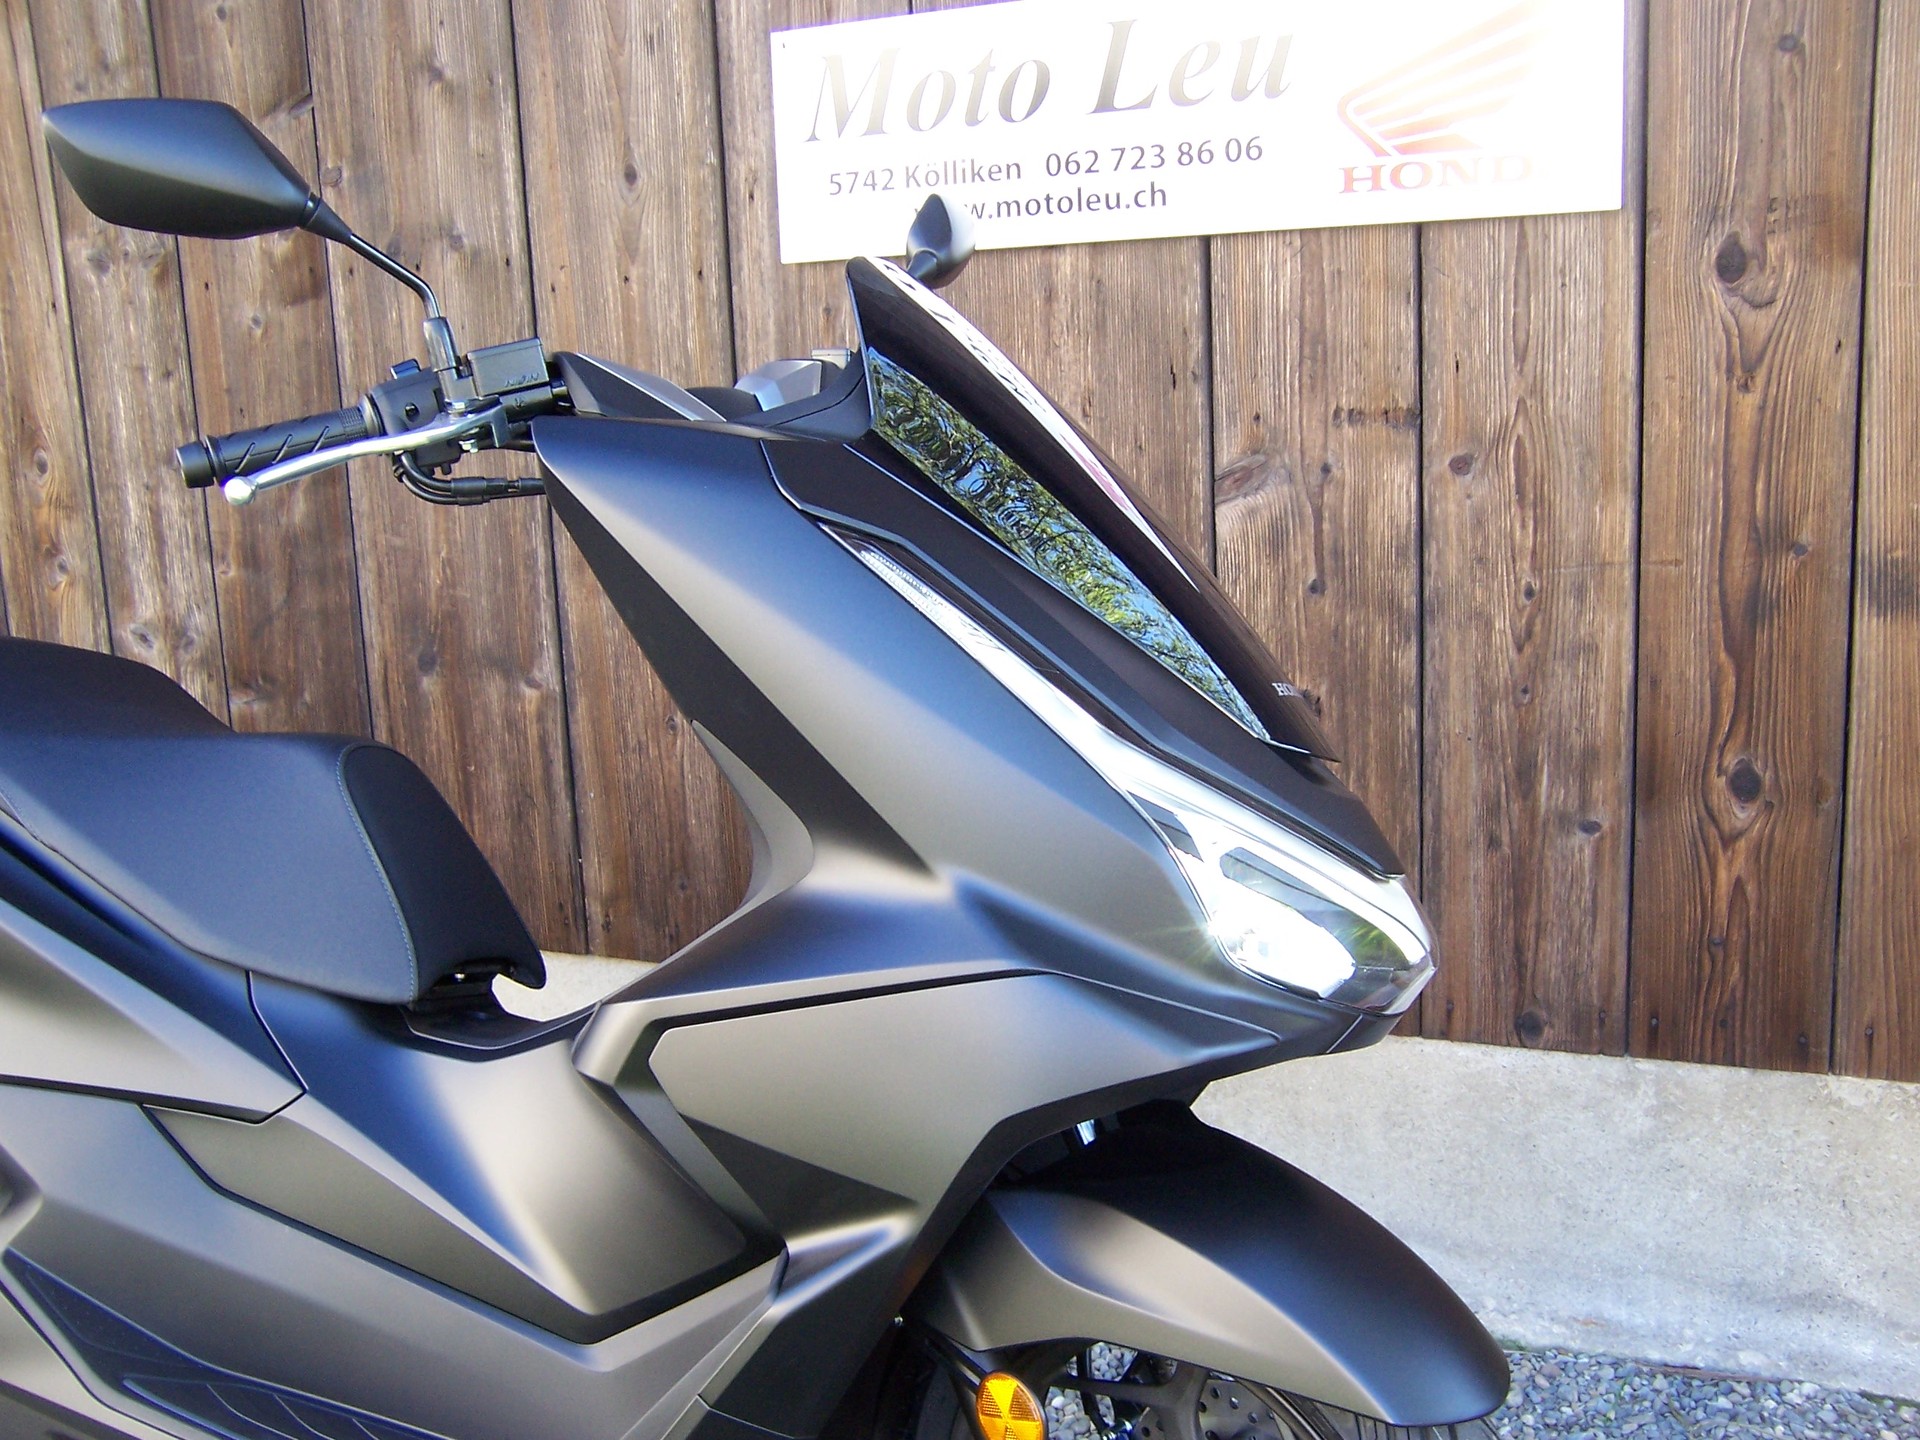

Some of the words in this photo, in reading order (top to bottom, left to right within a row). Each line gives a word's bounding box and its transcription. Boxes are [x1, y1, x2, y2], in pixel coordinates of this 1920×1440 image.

[804, 48, 1050, 142] Moto
[1085, 19, 1293, 115] Leu
[829, 168, 895, 196] 5742
[905, 158, 1022, 189] Kölliken
[1045, 150, 1100, 177] 062
[1110, 144, 1166, 172] 723
[1177, 139, 1214, 166] 86
[1225, 135, 1263, 162] 06
[1338, 154, 1534, 194] HOND
[914, 181, 1167, 220] w.motoleu.ch
